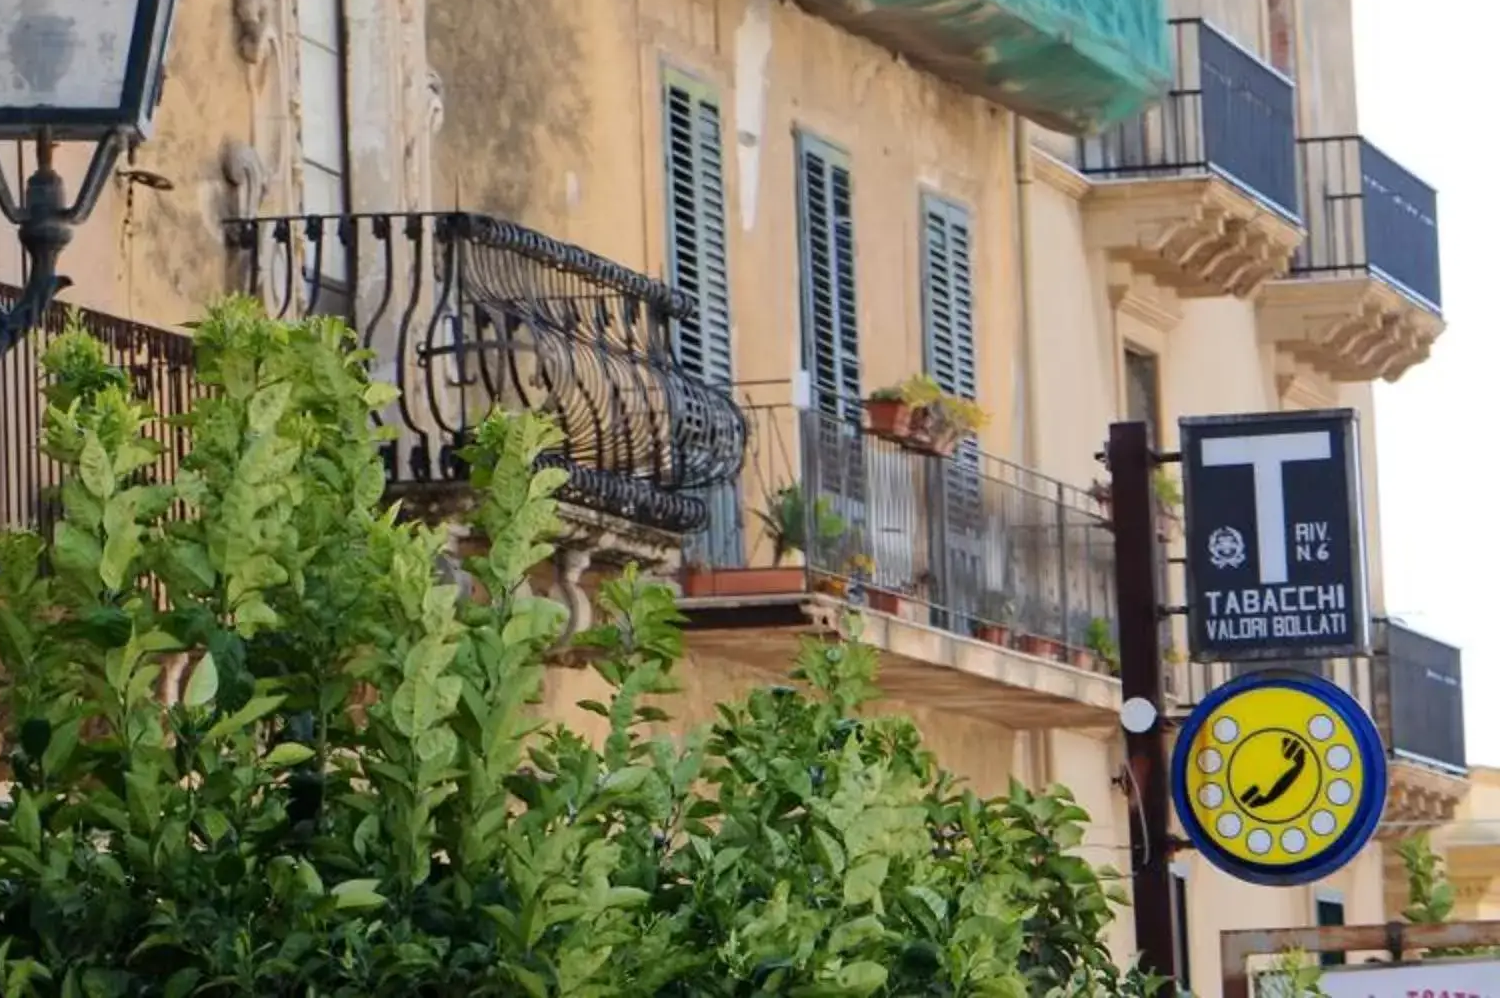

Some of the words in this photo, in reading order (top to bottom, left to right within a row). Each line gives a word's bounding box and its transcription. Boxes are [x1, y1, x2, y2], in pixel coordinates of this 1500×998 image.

[1202, 431, 1331, 584] T
[1316, 543, 1329, 560] 6
[1205, 584, 1345, 615] TABACCHI
[1206, 617, 1268, 640] VALORI
[1272, 614, 1346, 637] BOLLATI
